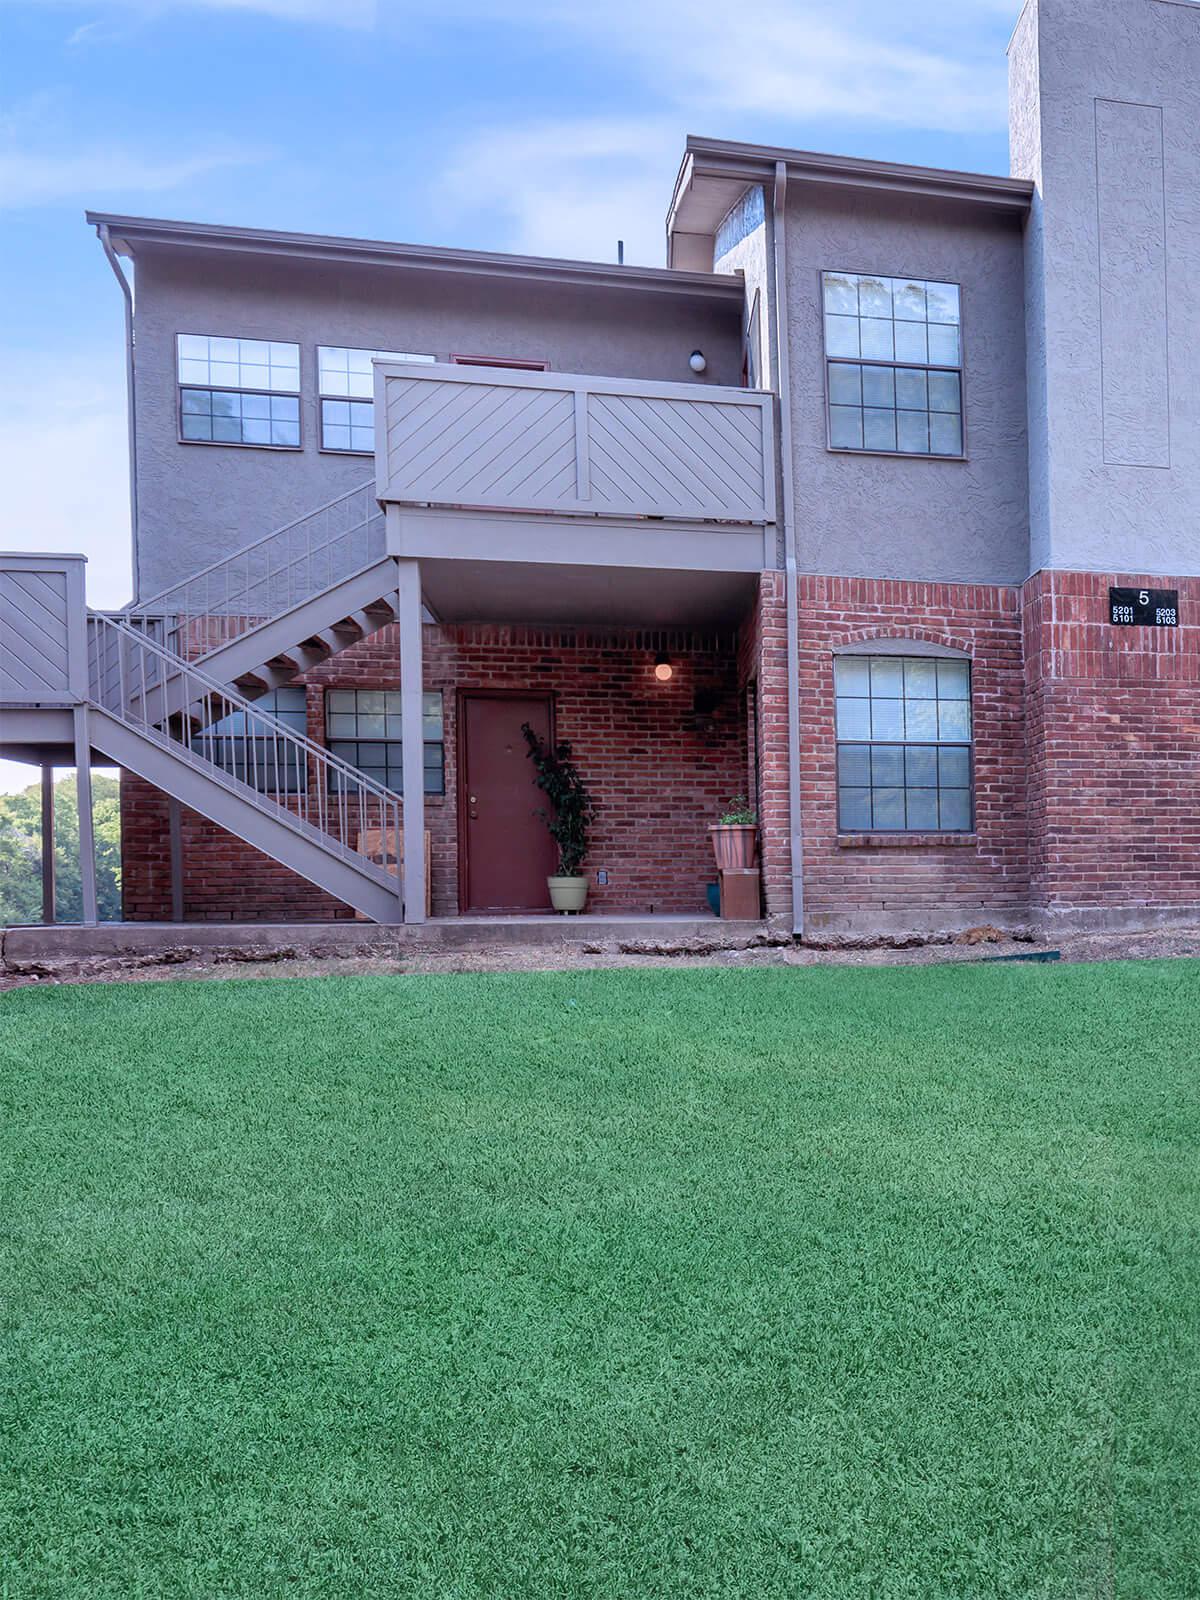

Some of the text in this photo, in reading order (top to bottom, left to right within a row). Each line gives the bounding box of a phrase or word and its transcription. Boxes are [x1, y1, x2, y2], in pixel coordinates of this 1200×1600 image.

[1139, 591, 1150, 605] 5
[1112, 606, 1134, 614] 5201
[1156, 608, 1176, 616] 5203
[1112, 614, 1134, 623] 5101
[1156, 616, 1176, 625] 5103
